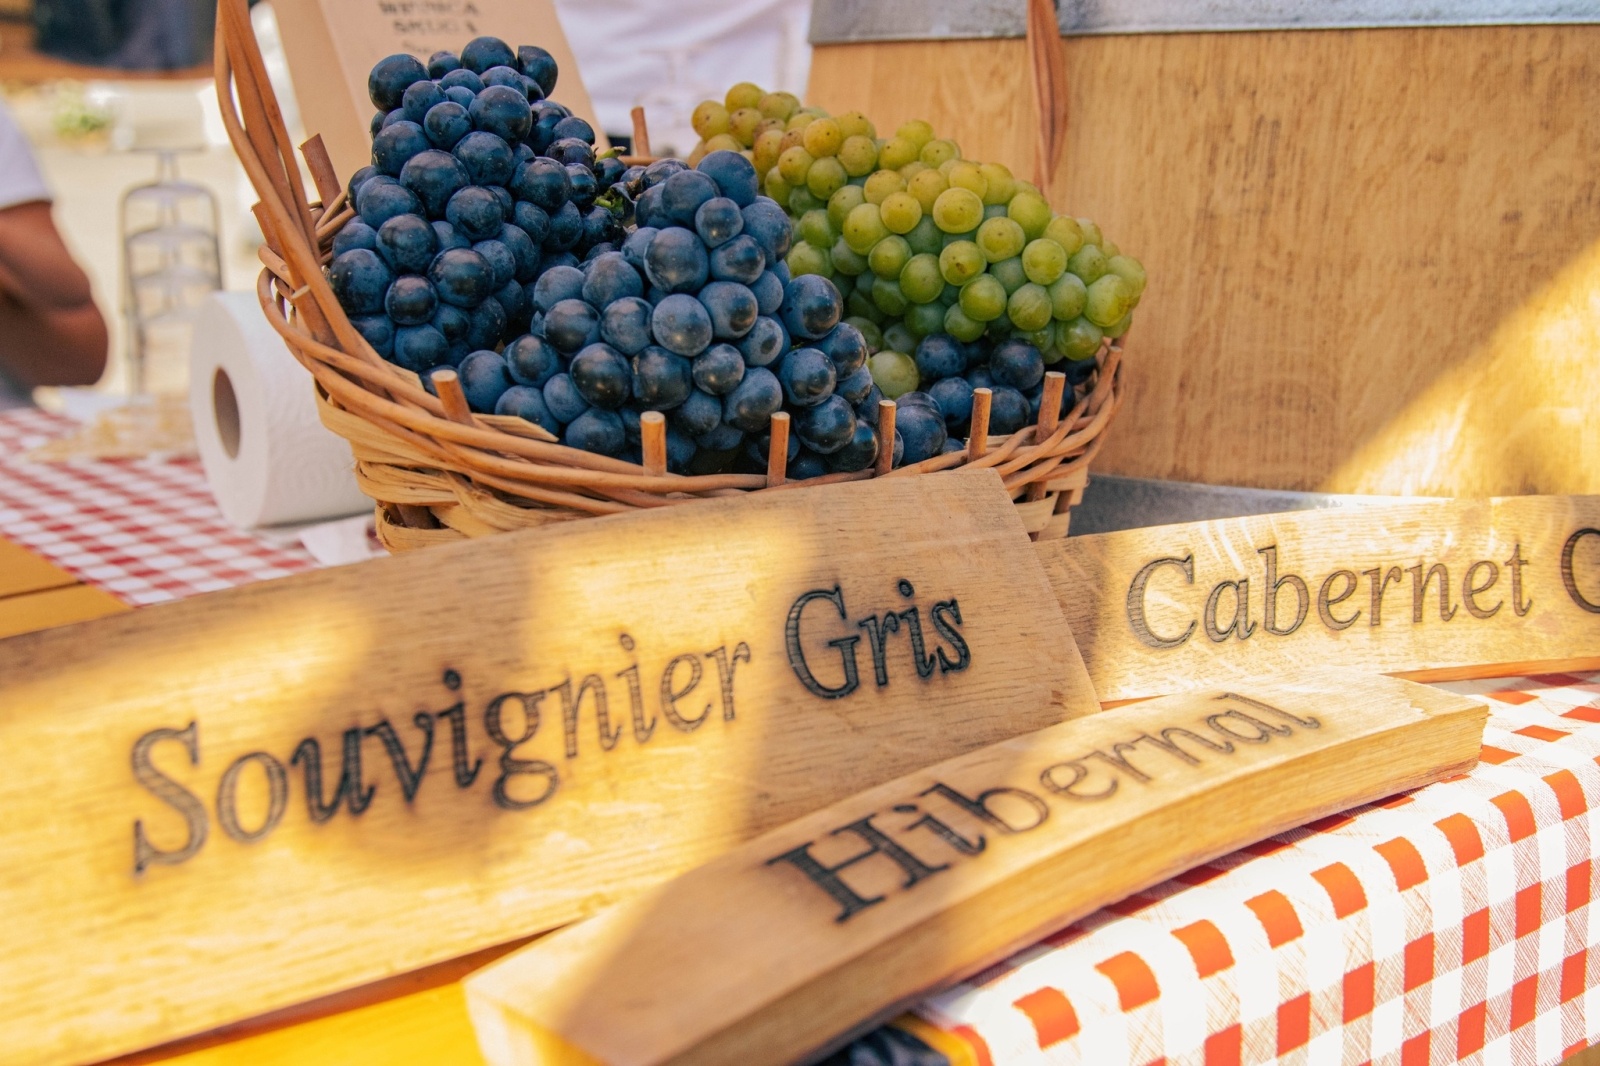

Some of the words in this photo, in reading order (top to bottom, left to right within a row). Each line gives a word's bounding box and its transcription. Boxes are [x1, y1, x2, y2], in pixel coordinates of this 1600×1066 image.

[1126, 545, 1533, 650] Cabernet
[129, 633, 752, 876] Souvignier
[784, 579, 971, 701] Gris
[767, 692, 1321, 924] Hibernal
